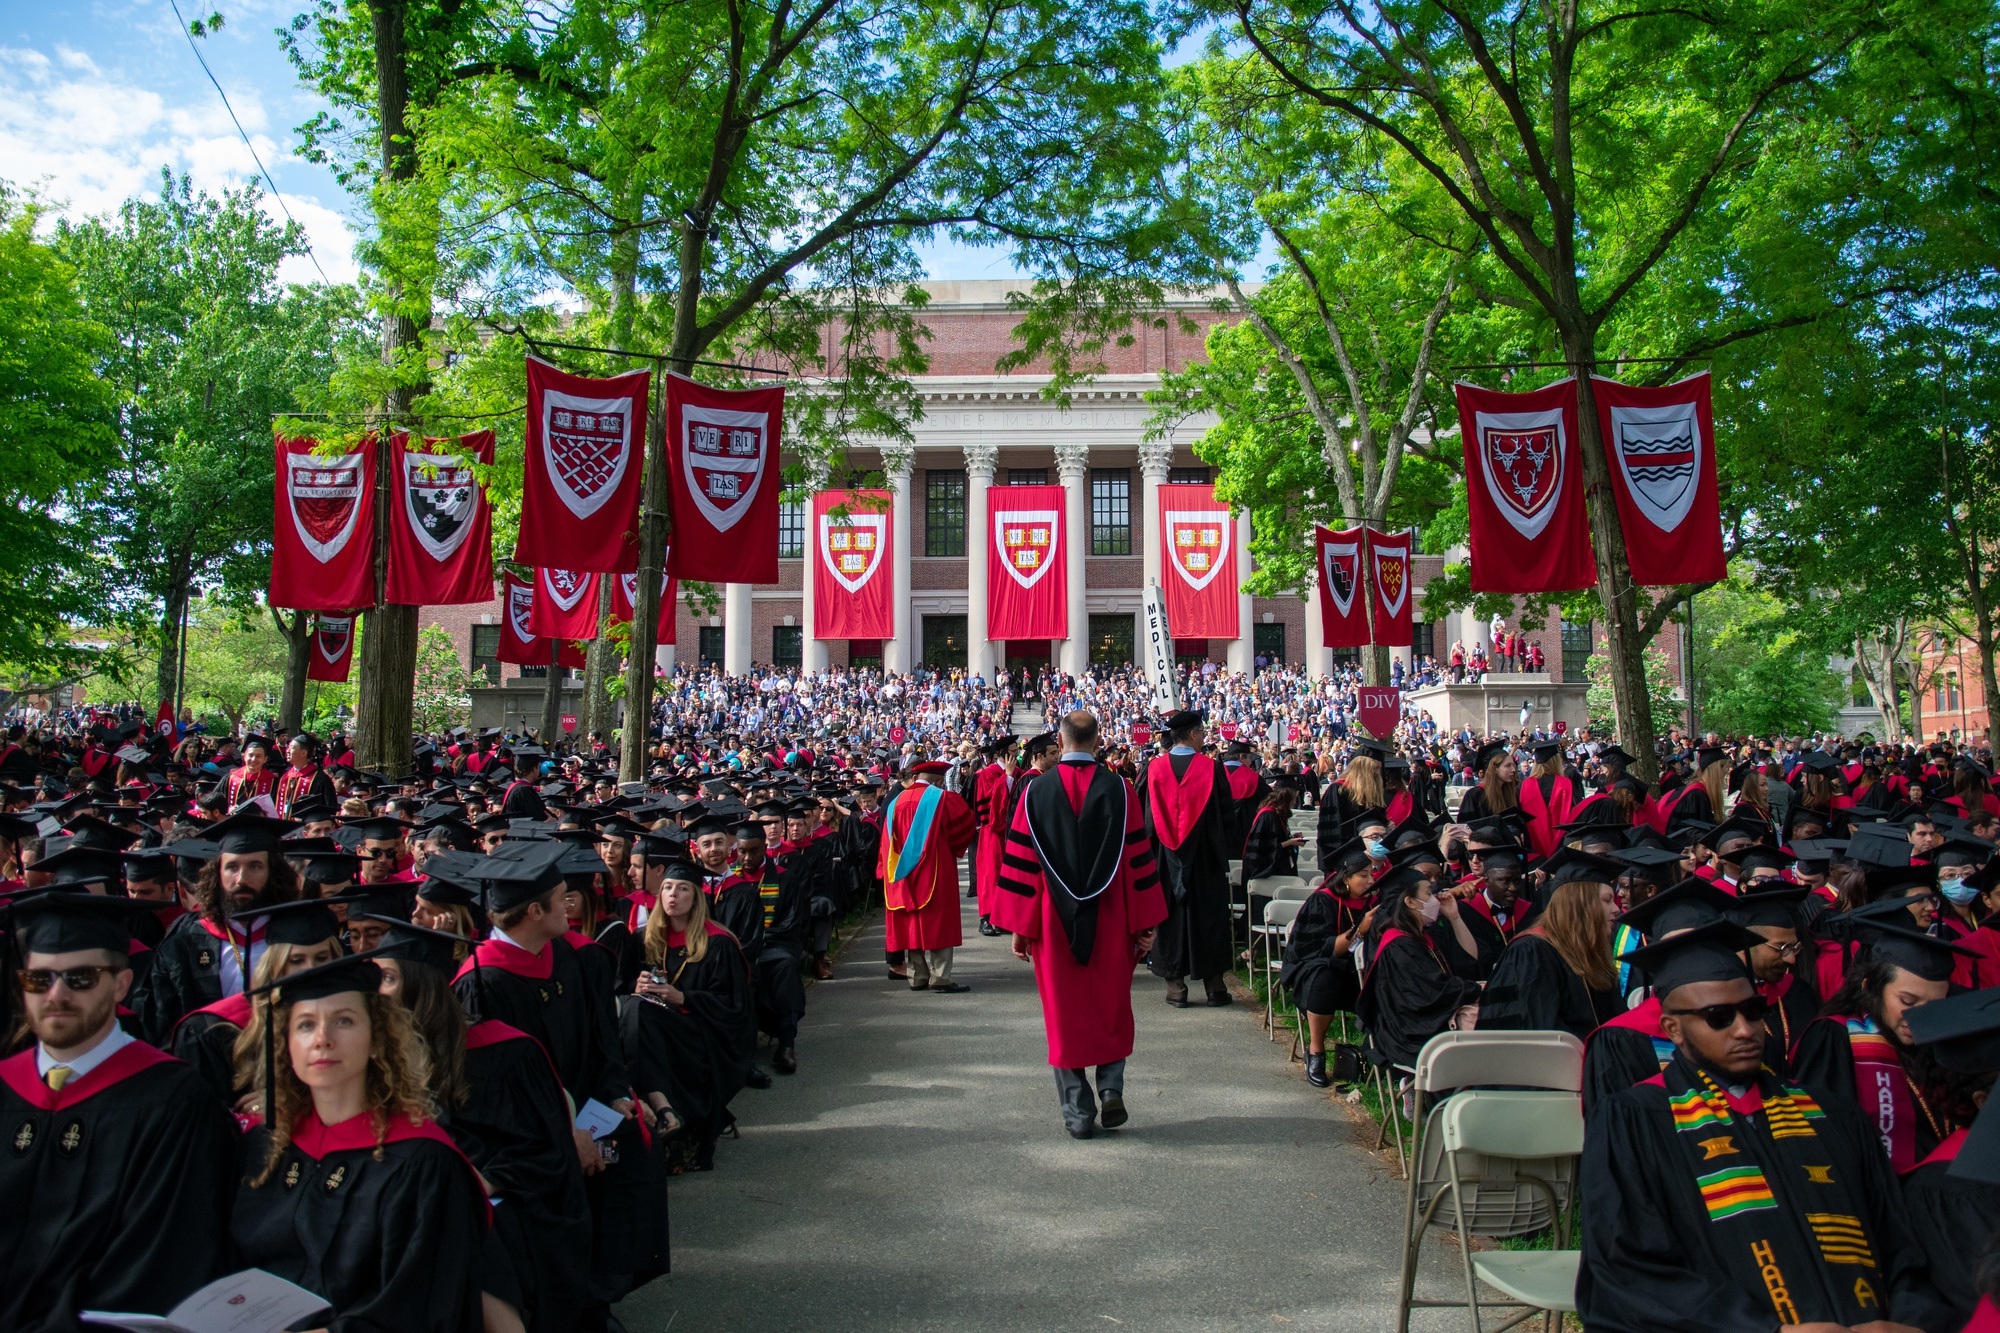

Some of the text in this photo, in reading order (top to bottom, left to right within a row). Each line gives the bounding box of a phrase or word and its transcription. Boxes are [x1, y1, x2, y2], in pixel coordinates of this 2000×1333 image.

[557, 414, 618, 427] VE RI TAS
[1006, 413, 1132, 427] MEMORIAL
[698, 431, 749, 448] VE RI
[714, 477, 734, 490] TAS
[1010, 532, 1043, 541] VE RI
[845, 557, 861, 566] TAS
[1020, 553, 1035, 562] TAS
[1190, 555, 1205, 564] TAS
[1147, 602, 1169, 700] MEDICAL
[1159, 602, 1178, 699] MEDICAL
[1364, 694, 1397, 709] DIV
[1133, 726, 1150, 734] HMS
[1222, 725, 1236, 733] GSD
[1557, 722, 1564, 730] G
[893, 729, 901, 738] G
[1289, 728, 1296, 736] G
[1875, 1071, 1894, 1159] HARVA
